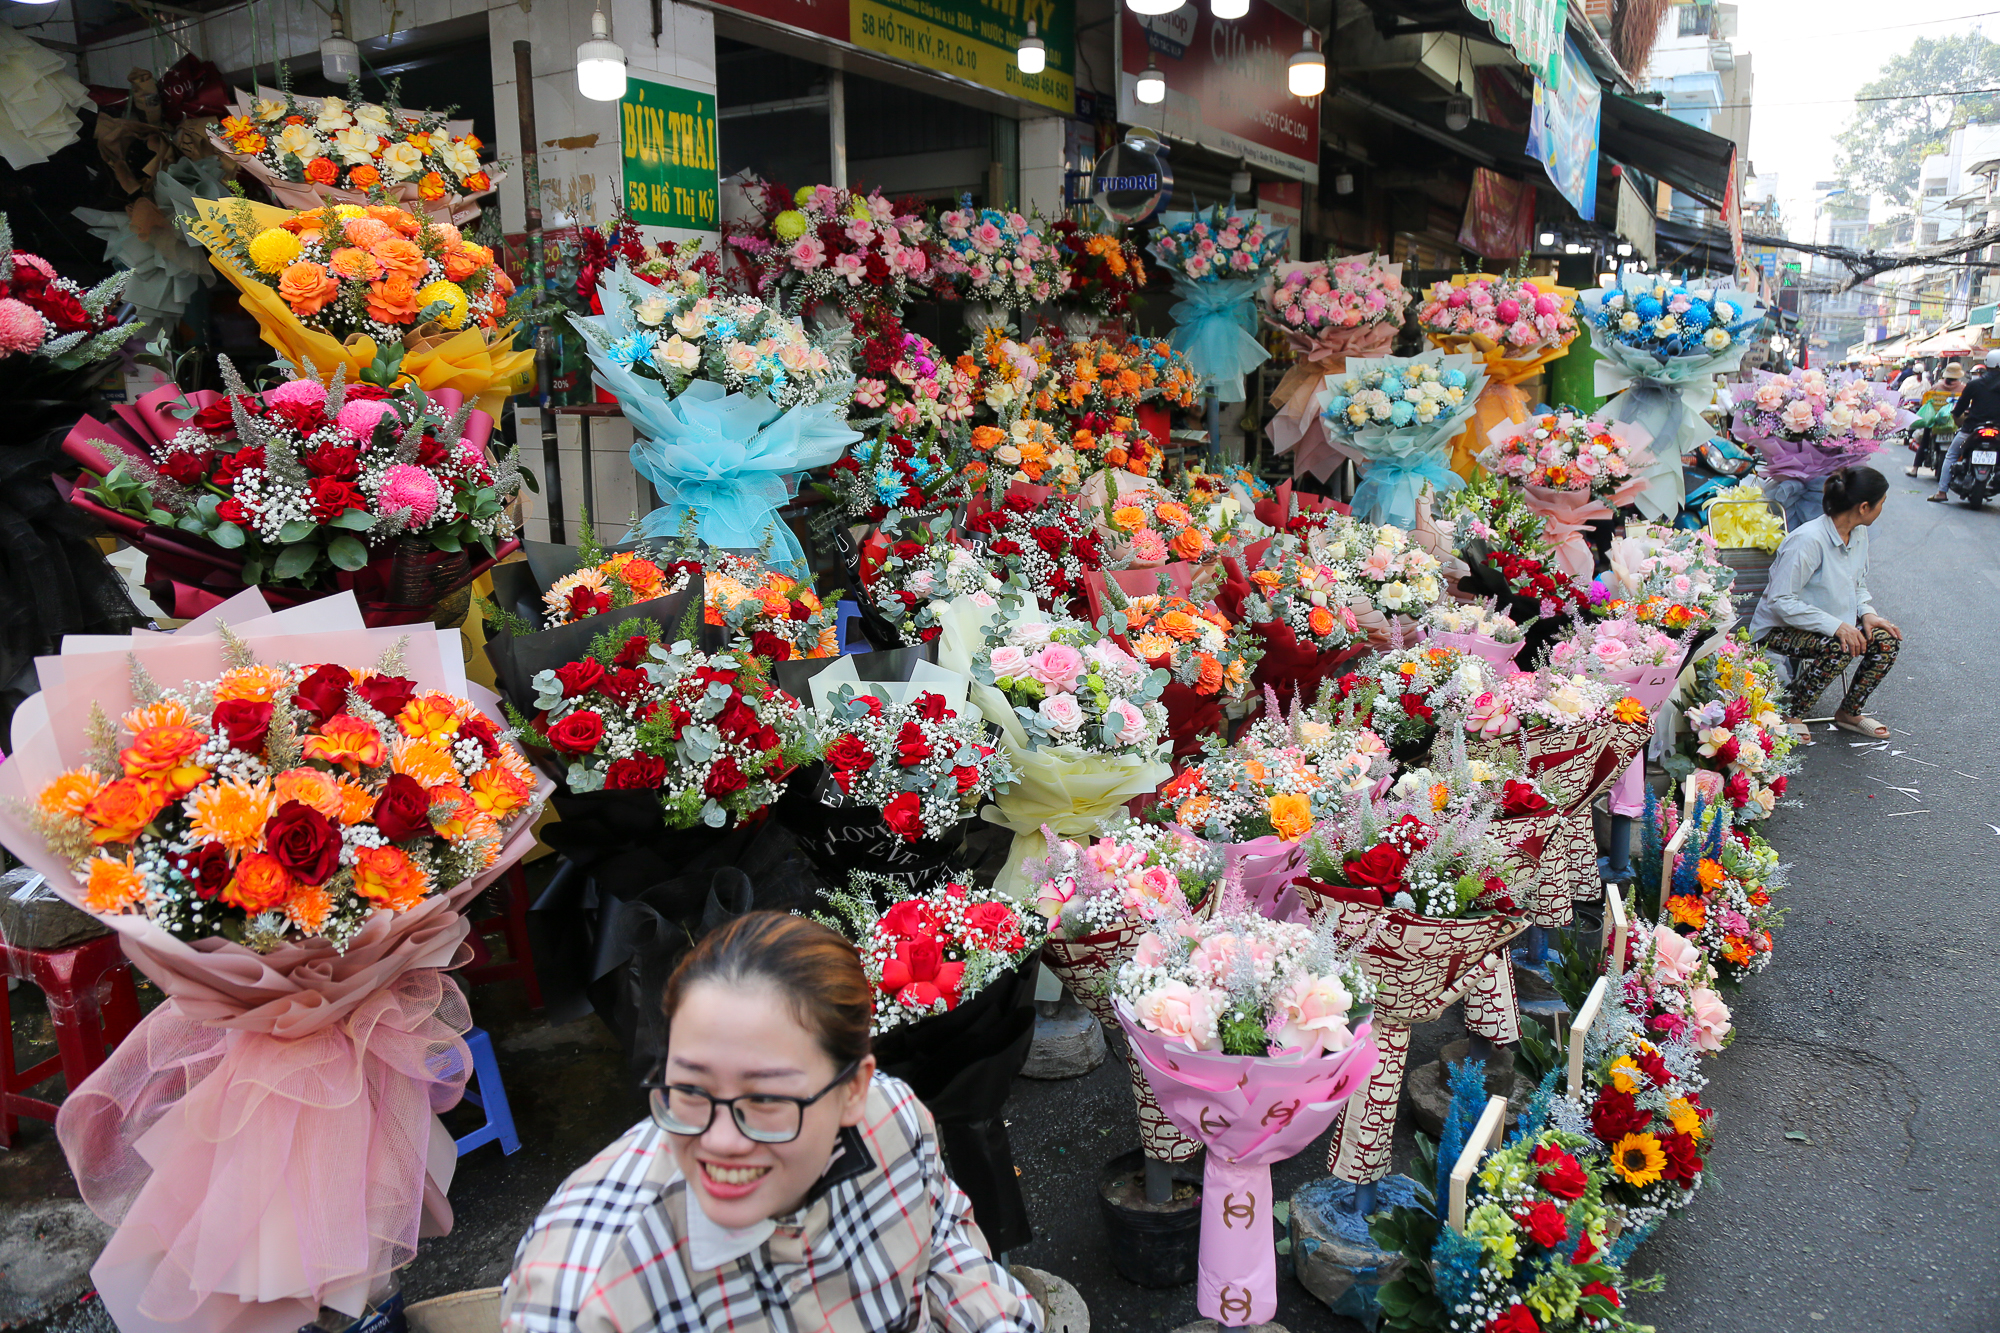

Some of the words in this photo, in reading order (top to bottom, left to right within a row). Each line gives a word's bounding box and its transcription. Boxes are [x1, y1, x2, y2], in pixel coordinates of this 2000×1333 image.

[862, 12, 875, 36] 58
[878, 12, 895, 42] HỒ
[897, 24, 915, 54] THỊ
[937, 38, 954, 66] P.1,
[956, 45, 977, 71] Q.10
[957, 11, 973, 32] BIA
[980, 20, 1004, 44] NƯỚC
[1005, 62, 1020, 85] ĐT:
[1021, 73, 1040, 91] 0859
[1041, 77, 1055, 97] 464
[1056, 81, 1069, 102] 643
[1081, 99, 1091, 115] 58
[623, 88, 664, 162] BÚN
[668, 100, 715, 170] THÁI
[1280, 113, 1293, 136] CÁC
[1294, 121, 1308, 145] LOẠI
[1097, 173, 1157, 192] TUBORG
[629, 181, 648, 211] 58
[651, 182, 670, 214] Hồ
[673, 187, 696, 223] Thị
[698, 188, 715, 223] Kỷ
[553, 379, 569, 389] 20%
